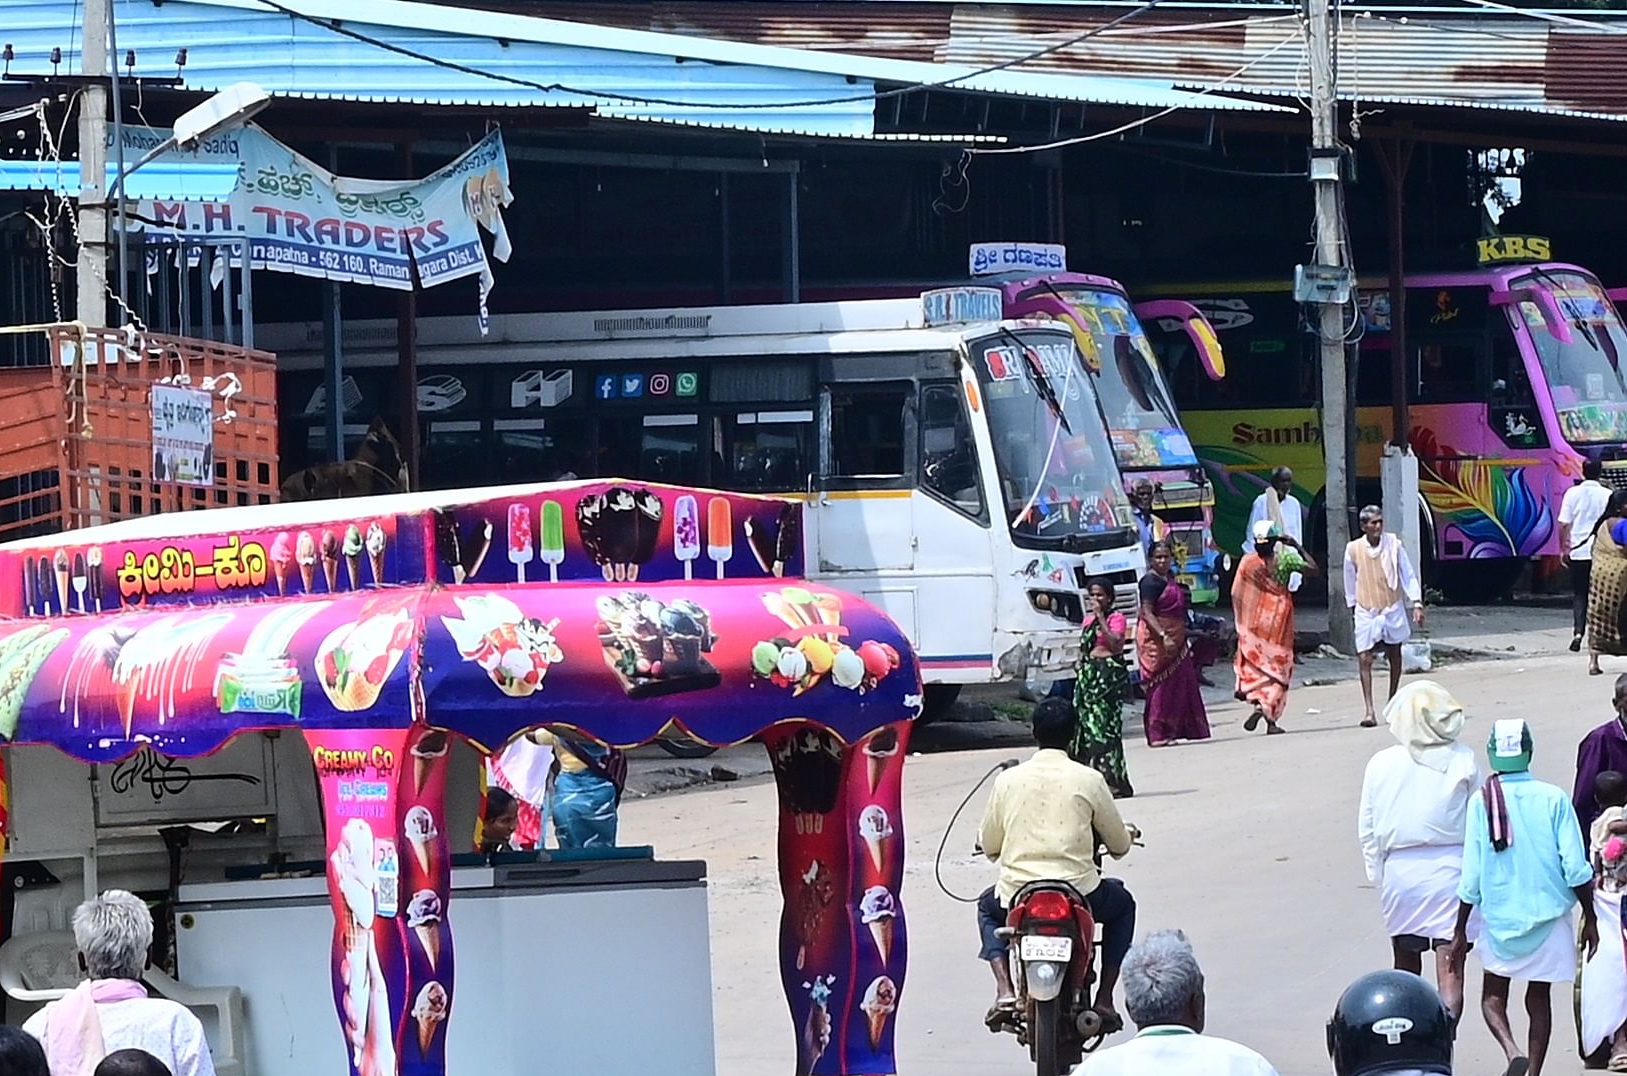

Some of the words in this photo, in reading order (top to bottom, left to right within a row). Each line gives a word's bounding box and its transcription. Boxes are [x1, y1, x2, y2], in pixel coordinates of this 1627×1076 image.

[251, 205, 450, 255] TRADERS
[974, 247, 998, 273] ಶ್ರೀ
[1477, 237, 1551, 263] KBS
[953, 293, 1001, 321] TRAVELS
